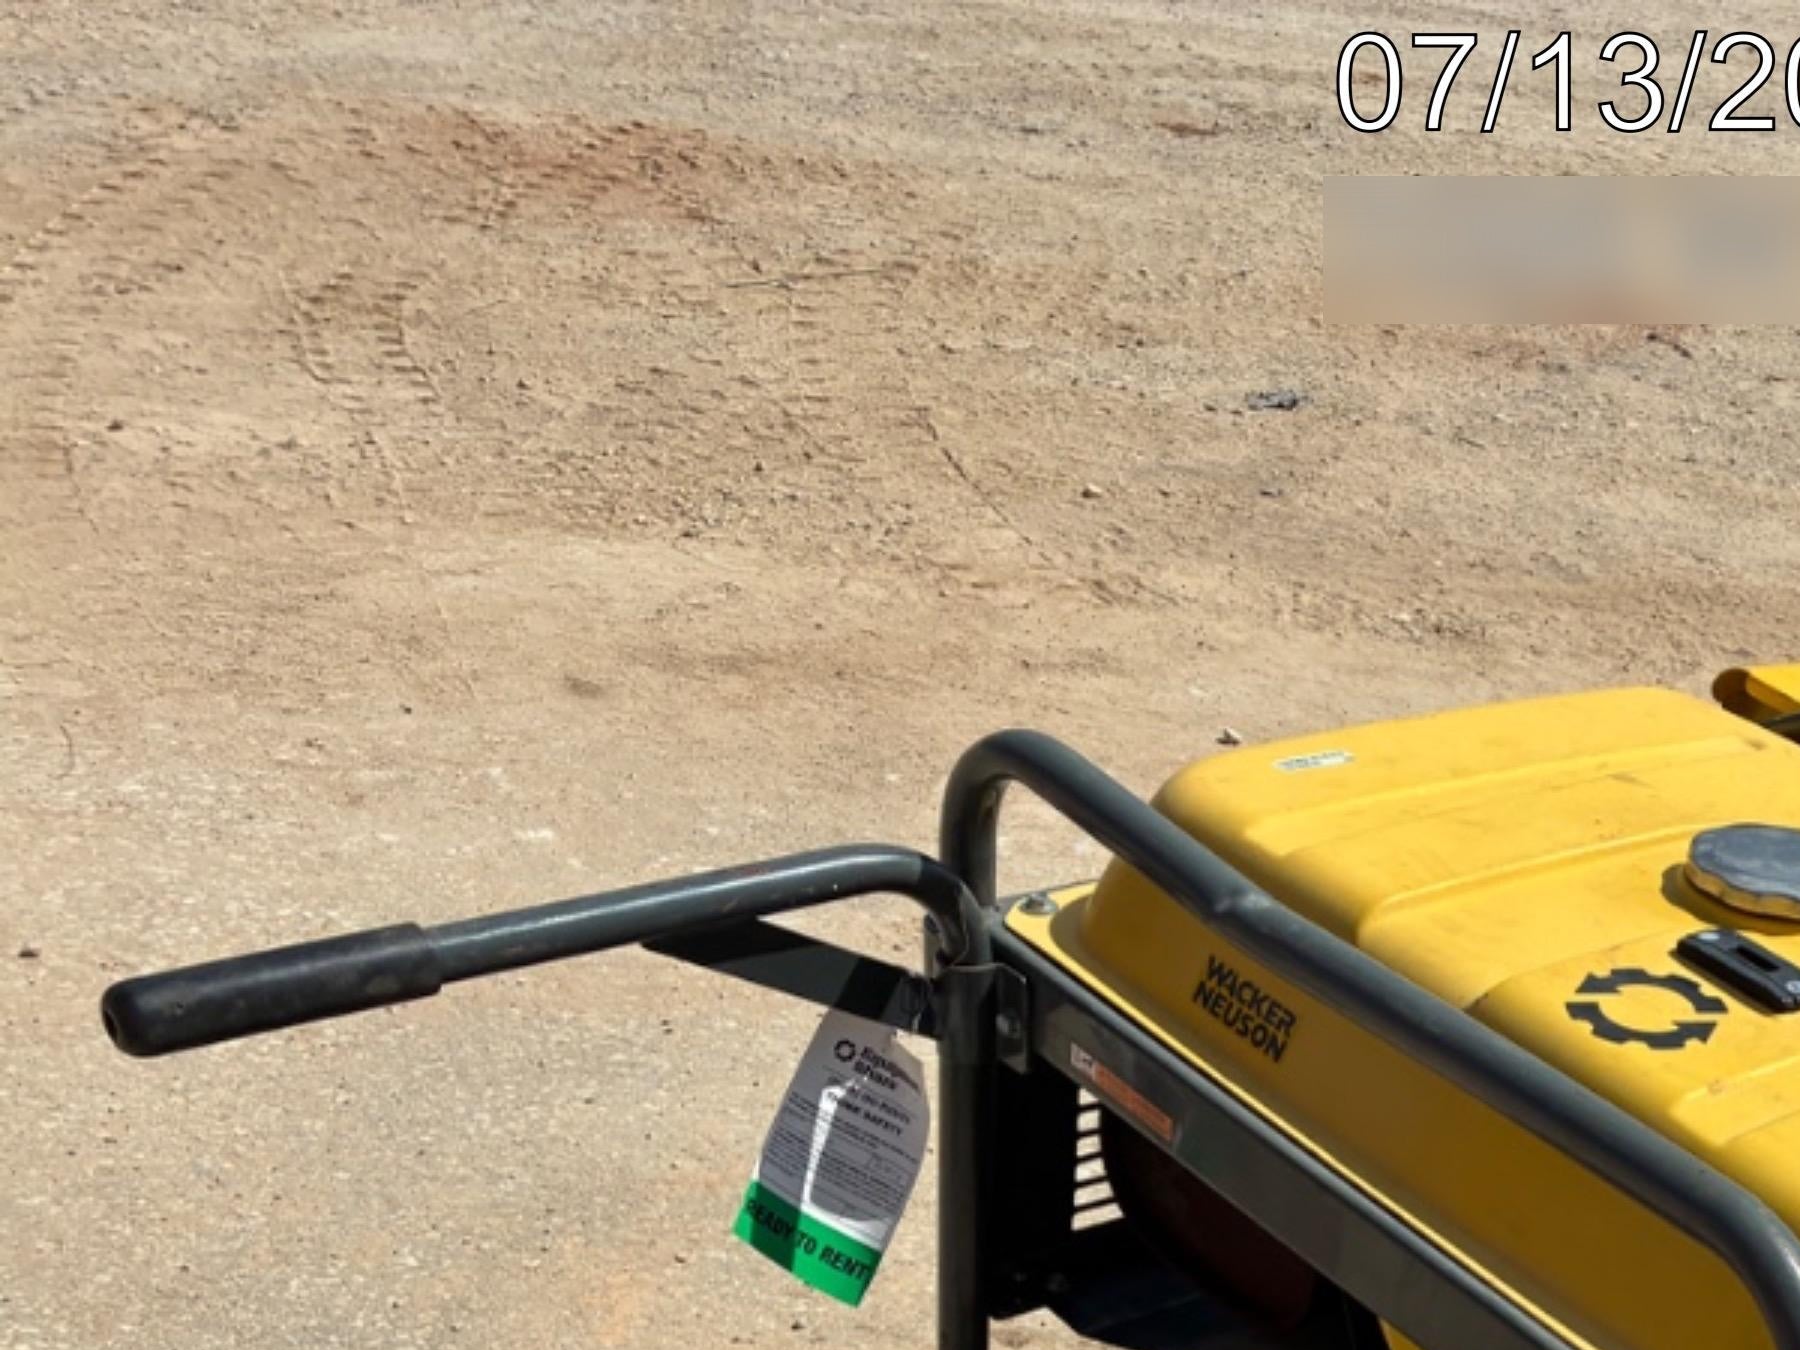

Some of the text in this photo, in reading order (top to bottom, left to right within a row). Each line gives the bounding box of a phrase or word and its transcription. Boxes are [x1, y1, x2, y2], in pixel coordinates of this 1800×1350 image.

[1192, 980, 1288, 1062] NEUSON
[1207, 954, 1296, 1038] WACKER
[745, 1199, 796, 1240] READY
[798, 1231, 818, 1256] TO
